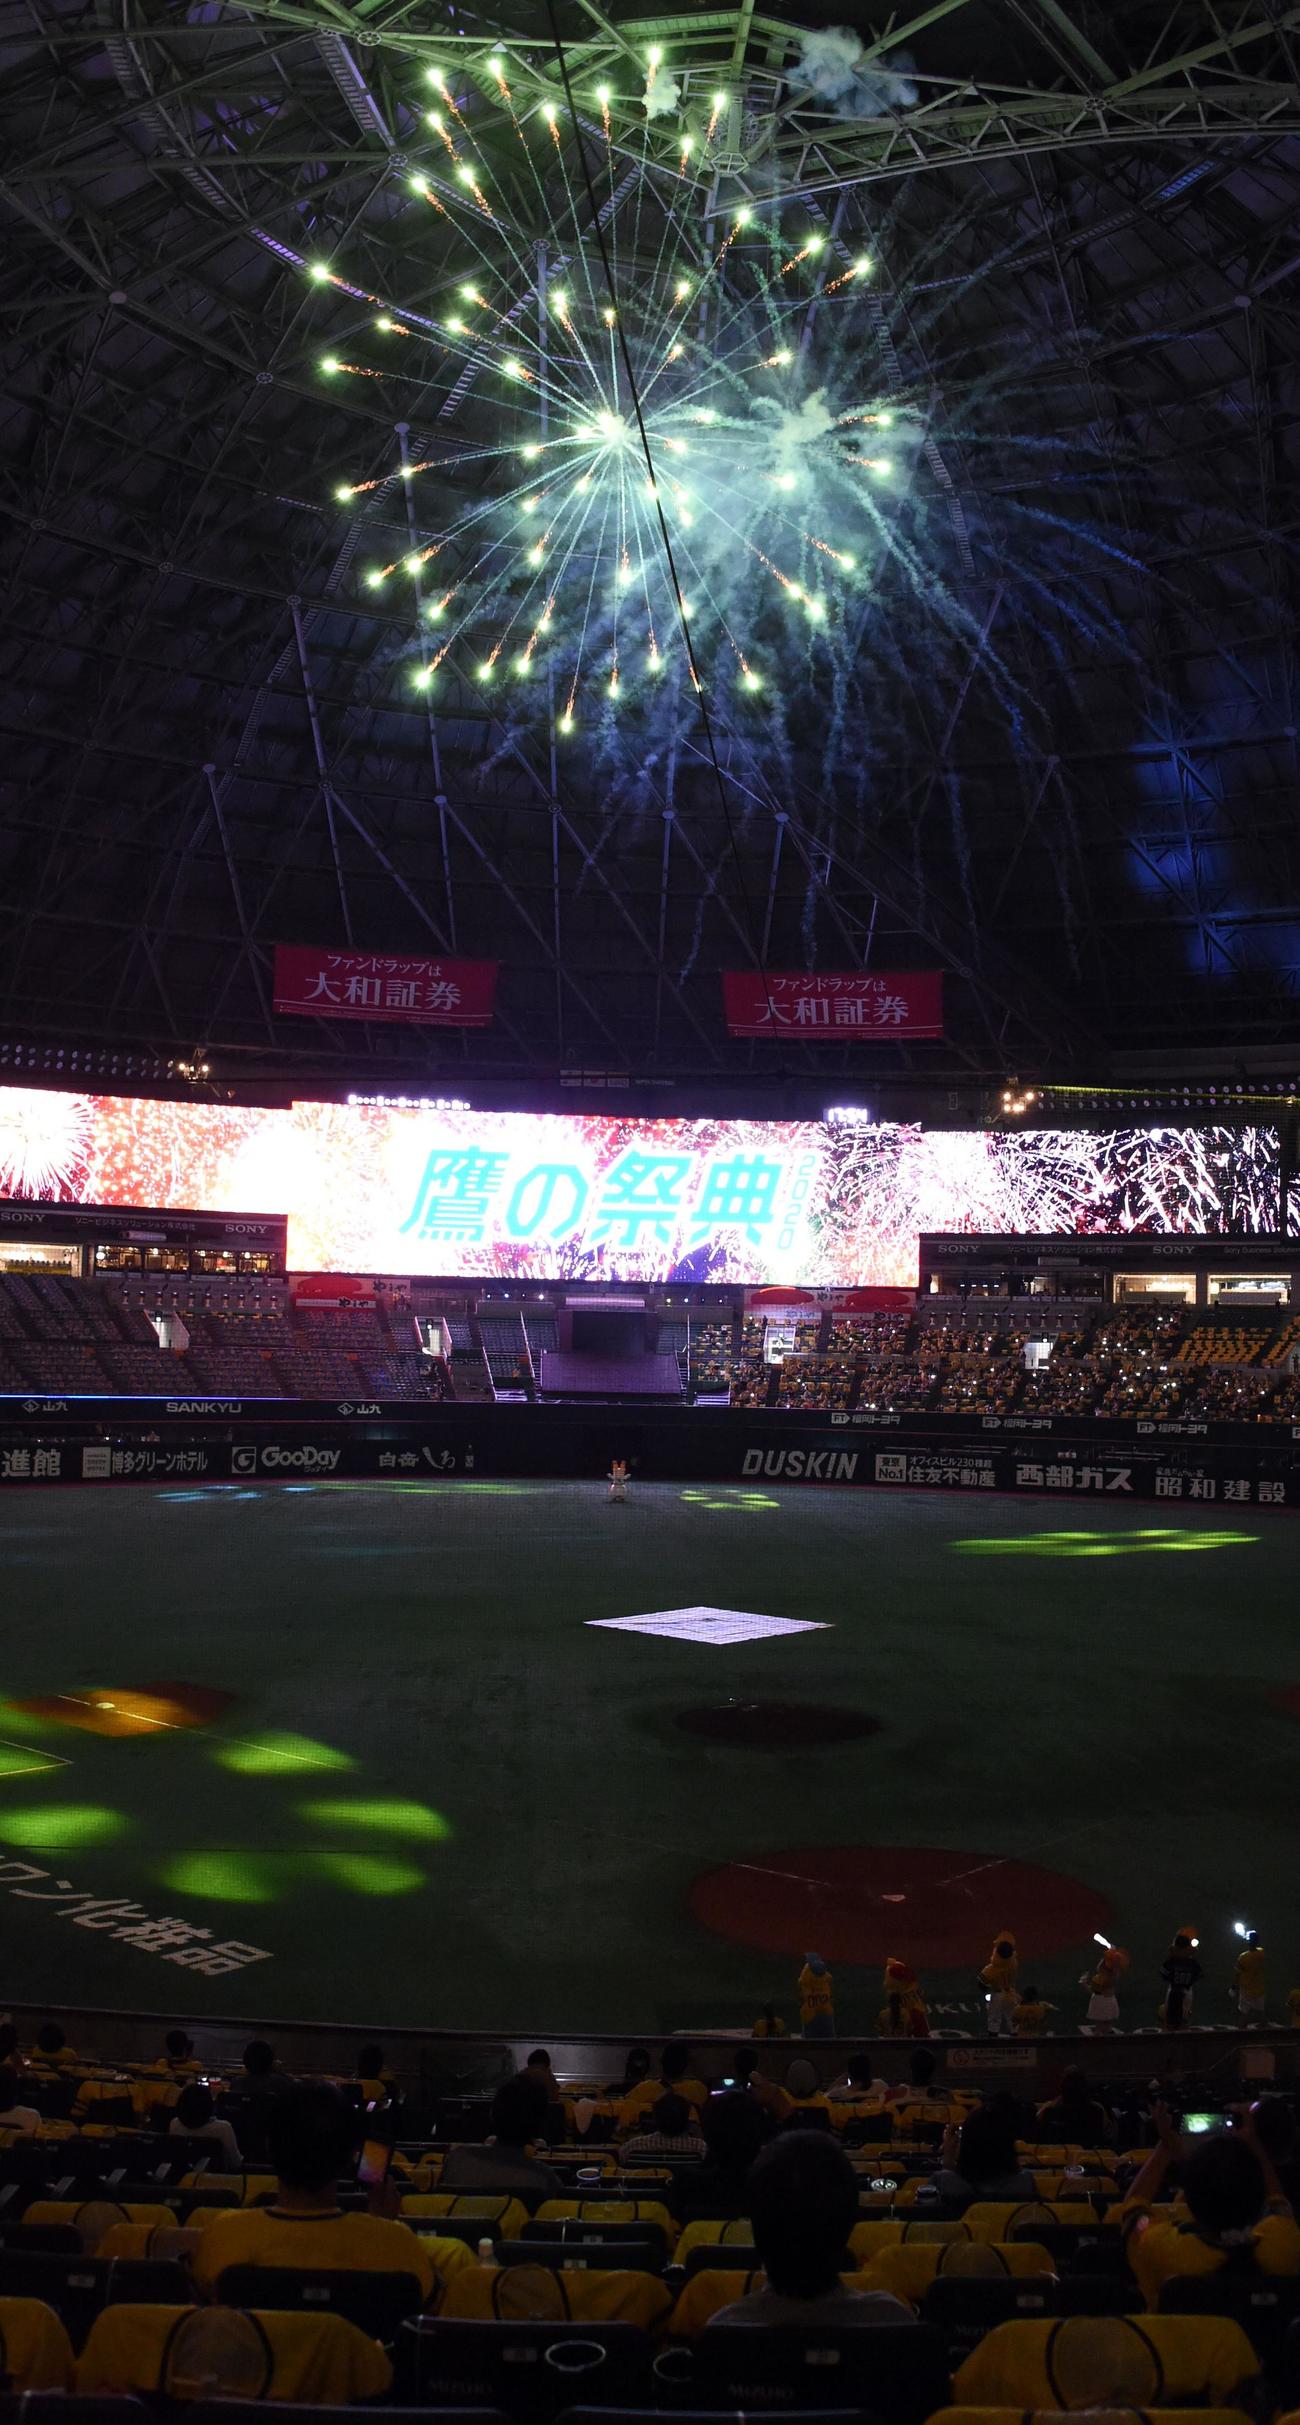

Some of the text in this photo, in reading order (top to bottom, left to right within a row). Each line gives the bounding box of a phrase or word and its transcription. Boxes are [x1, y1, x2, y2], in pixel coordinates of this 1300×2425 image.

[327, 955, 442, 977] ファンドラップは
[304, 971, 462, 1010] 大和証券
[773, 977, 887, 992] ファンドラップは
[754, 996, 909, 1025] 大和証券
[399, 1145, 782, 1247] 鷹の祭典
[1, 1212, 46, 1223] SONY
[225, 1224, 268, 1234] SONY
[938, 1244, 980, 1254] SONY
[1152, 1245, 1195, 1255] SONY
[42, 1400, 69, 1412] 山九
[166, 1401, 242, 1413] SANKYU
[356, 1403, 381, 1415] 山九
[0, 1449, 61, 1477] 進館
[112, 1451, 208, 1474] 博多グリーンホテル
[261, 1446, 342, 1470] GooDay
[879, 1467, 903, 1480] No.1
[908, 1466, 996, 1487] 住友不動産
[1016, 1463, 1135, 1491] 西部ガス
[1155, 1476, 1286, 1503] 昭和建設
[0, 1855, 275, 1976] ロン化粧品
